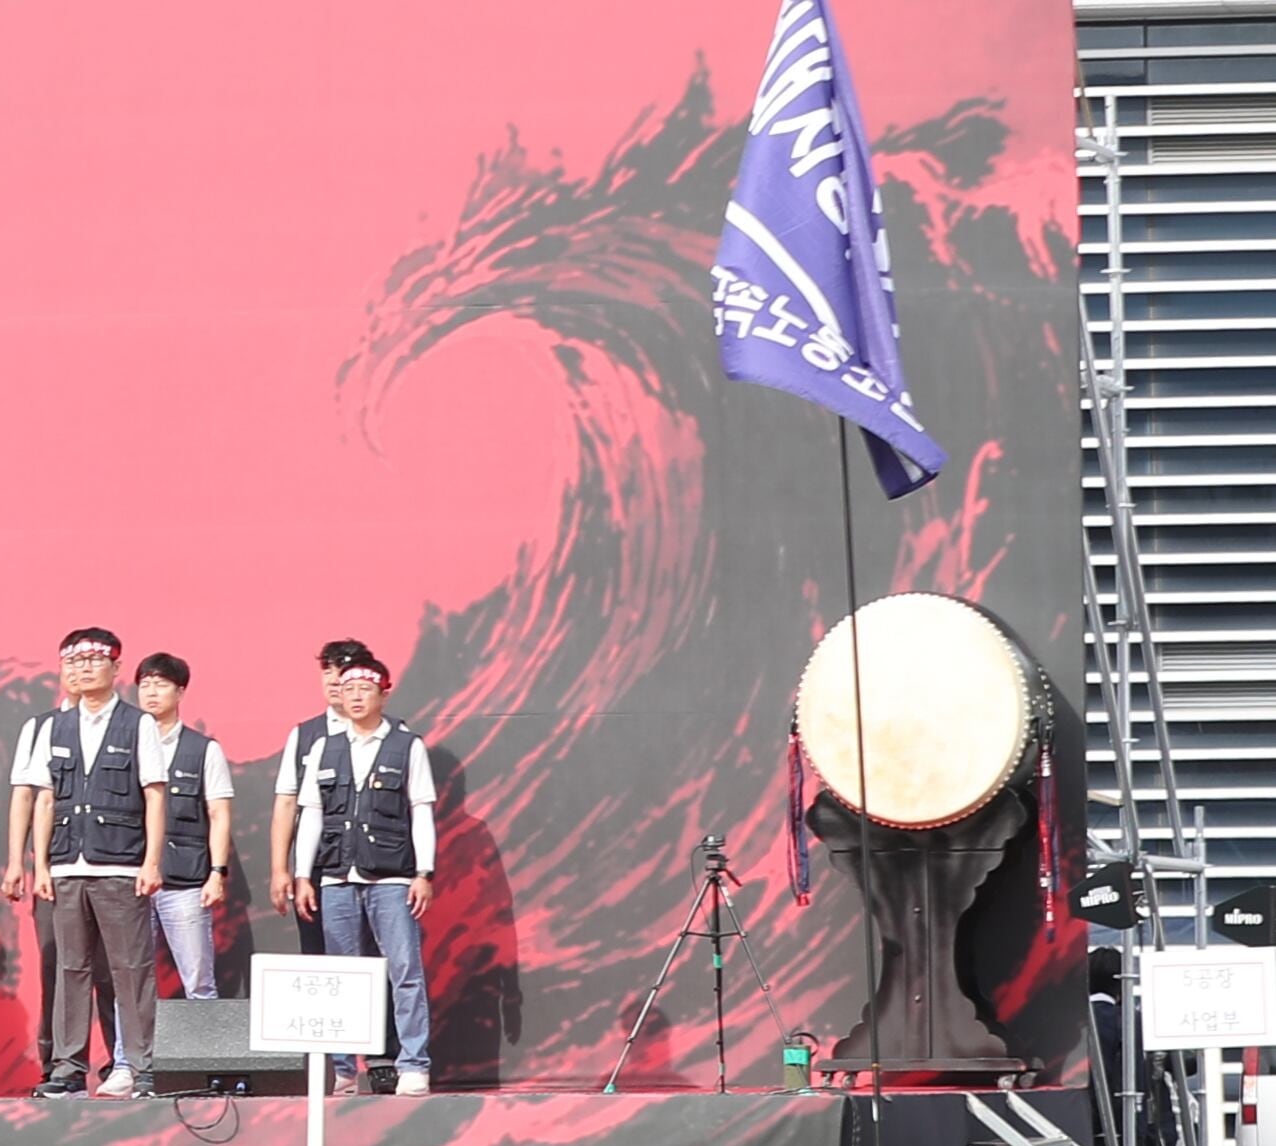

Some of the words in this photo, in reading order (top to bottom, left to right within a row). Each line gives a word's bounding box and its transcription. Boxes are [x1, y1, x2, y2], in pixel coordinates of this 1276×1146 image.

[291, 975, 343, 996] 4공장
[286, 1016, 346, 1038] 사업부
[1179, 1010, 1241, 1032] 사업부
